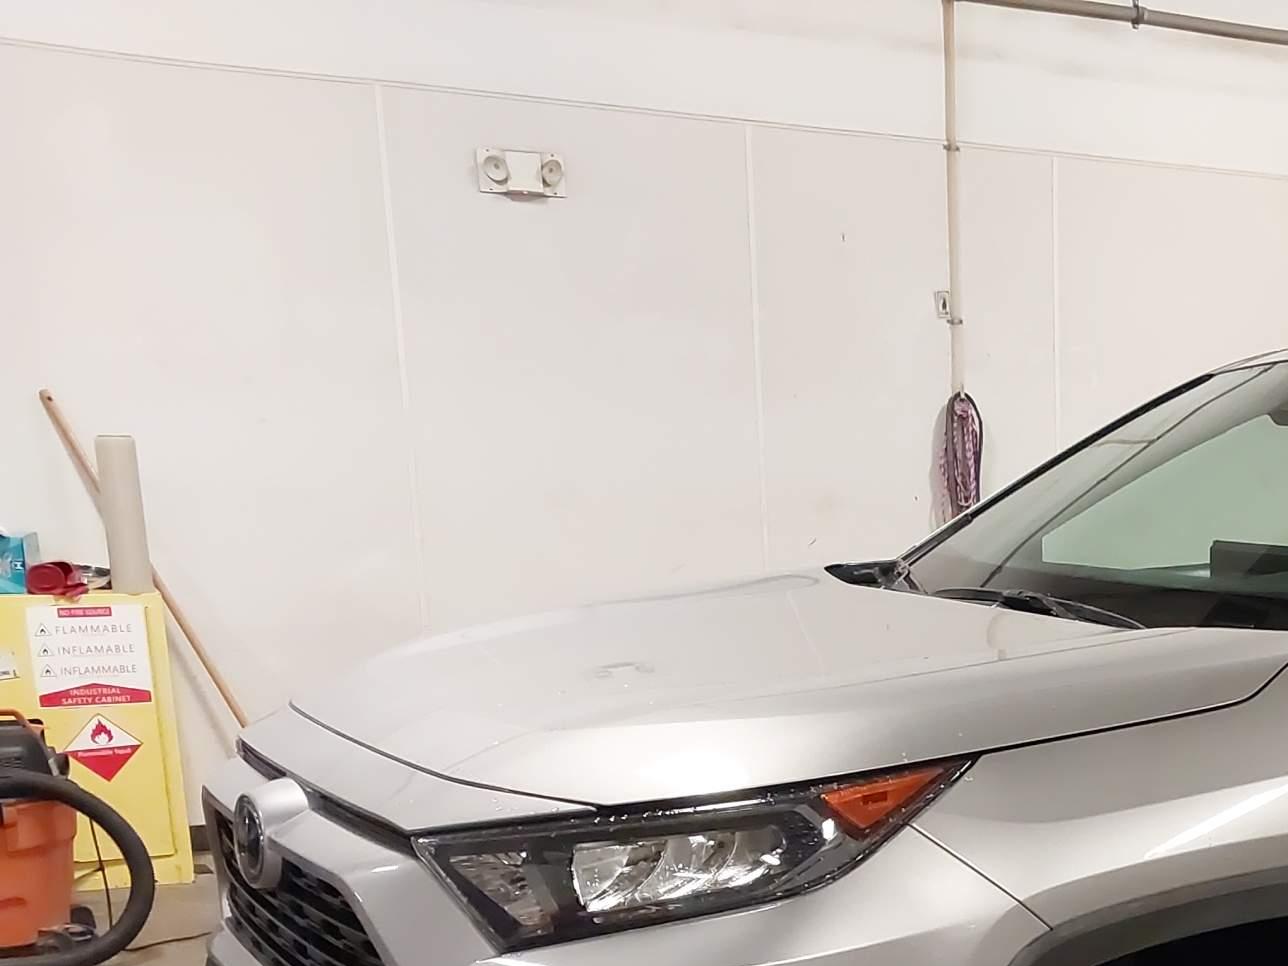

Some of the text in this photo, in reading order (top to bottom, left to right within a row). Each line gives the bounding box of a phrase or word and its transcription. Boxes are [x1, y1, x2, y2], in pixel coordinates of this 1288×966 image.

[55, 623, 133, 635] FLAMMABLE
[57, 643, 135, 656] INFLAMABLE
[60, 664, 137, 676] INFLAMMABLE
[69, 687, 121, 696] INDUSTRIAL
[61, 695, 131, 705] SAFETY CABINET
